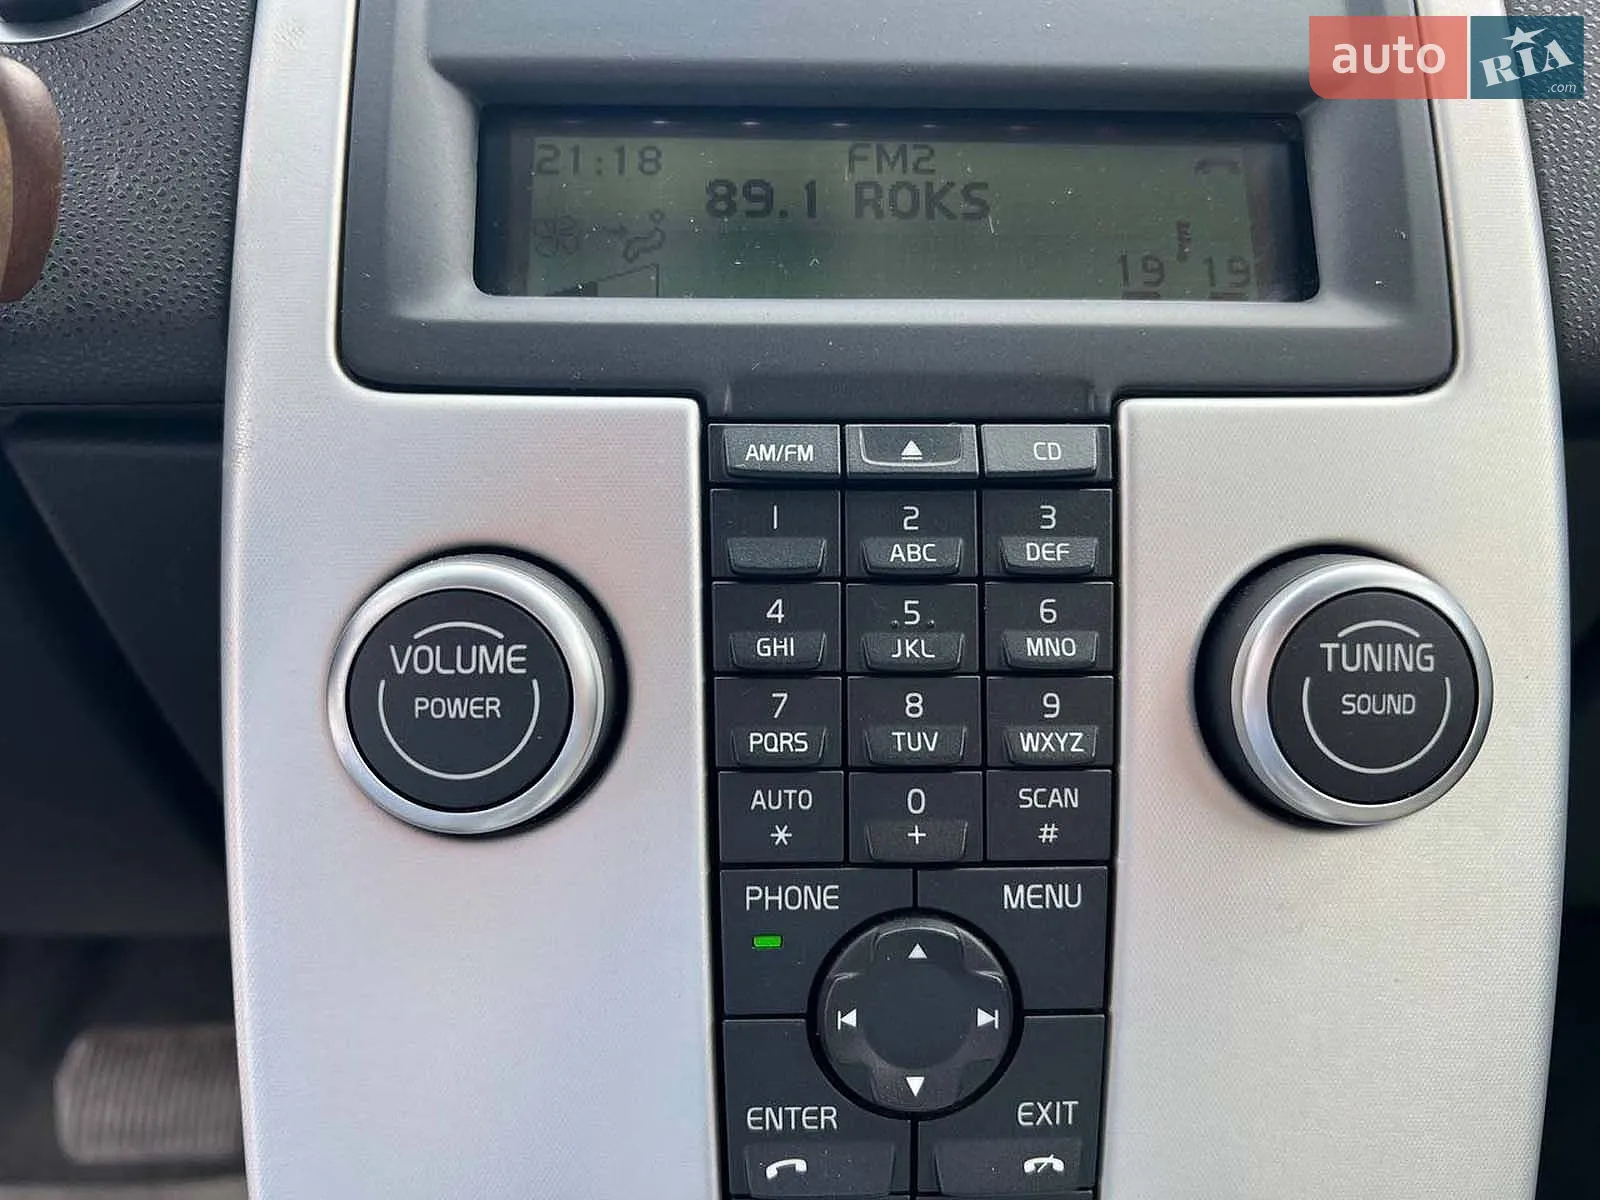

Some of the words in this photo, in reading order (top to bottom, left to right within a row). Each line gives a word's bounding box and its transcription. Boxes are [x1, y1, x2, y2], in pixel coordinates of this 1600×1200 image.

[536, 144, 663, 175] 21:18
[848, 143, 936, 175] FM2
[705, 179, 817, 219] 89.1
[854, 181, 990, 220] ROKS
[1119, 254, 1165, 287] 19
[1205, 255, 1251, 287] 19
[745, 443, 814, 462] AM/FM
[1033, 441, 1062, 461] CD
[772, 505, 779, 530] 1
[903, 506, 920, 530] 2
[1040, 505, 1057, 530] 3
[889, 543, 937, 563] ABC
[1026, 542, 1070, 562] DEF
[766, 598, 785, 624] 4
[904, 600, 921, 625] 5
[1039, 598, 1057, 624] 6
[389, 643, 528, 676] VOLUME
[756, 637, 794, 657] GHI
[891, 638, 936, 658] JKL
[1026, 637, 1076, 657] MNO
[1319, 642, 1435, 673] TUNING
[414, 696, 502, 720] POWER
[772, 692, 788, 719] 7
[905, 692, 924, 718] 8
[1043, 692, 1060, 719] 9
[1341, 693, 1417, 716] SOUND
[749, 732, 809, 753] PQRS
[891, 731, 939, 752] TUV
[1019, 731, 1085, 752] WXYZ
[750, 789, 813, 810] AUTO
[907, 788, 926, 814] 0
[1018, 787, 1079, 809] SCAN
[1038, 823, 1059, 843] #
[745, 884, 840, 911] PHONE
[1003, 883, 1082, 909] MENU
[746, 1106, 838, 1131] ENTER
[1017, 1100, 1079, 1126] EXIT
